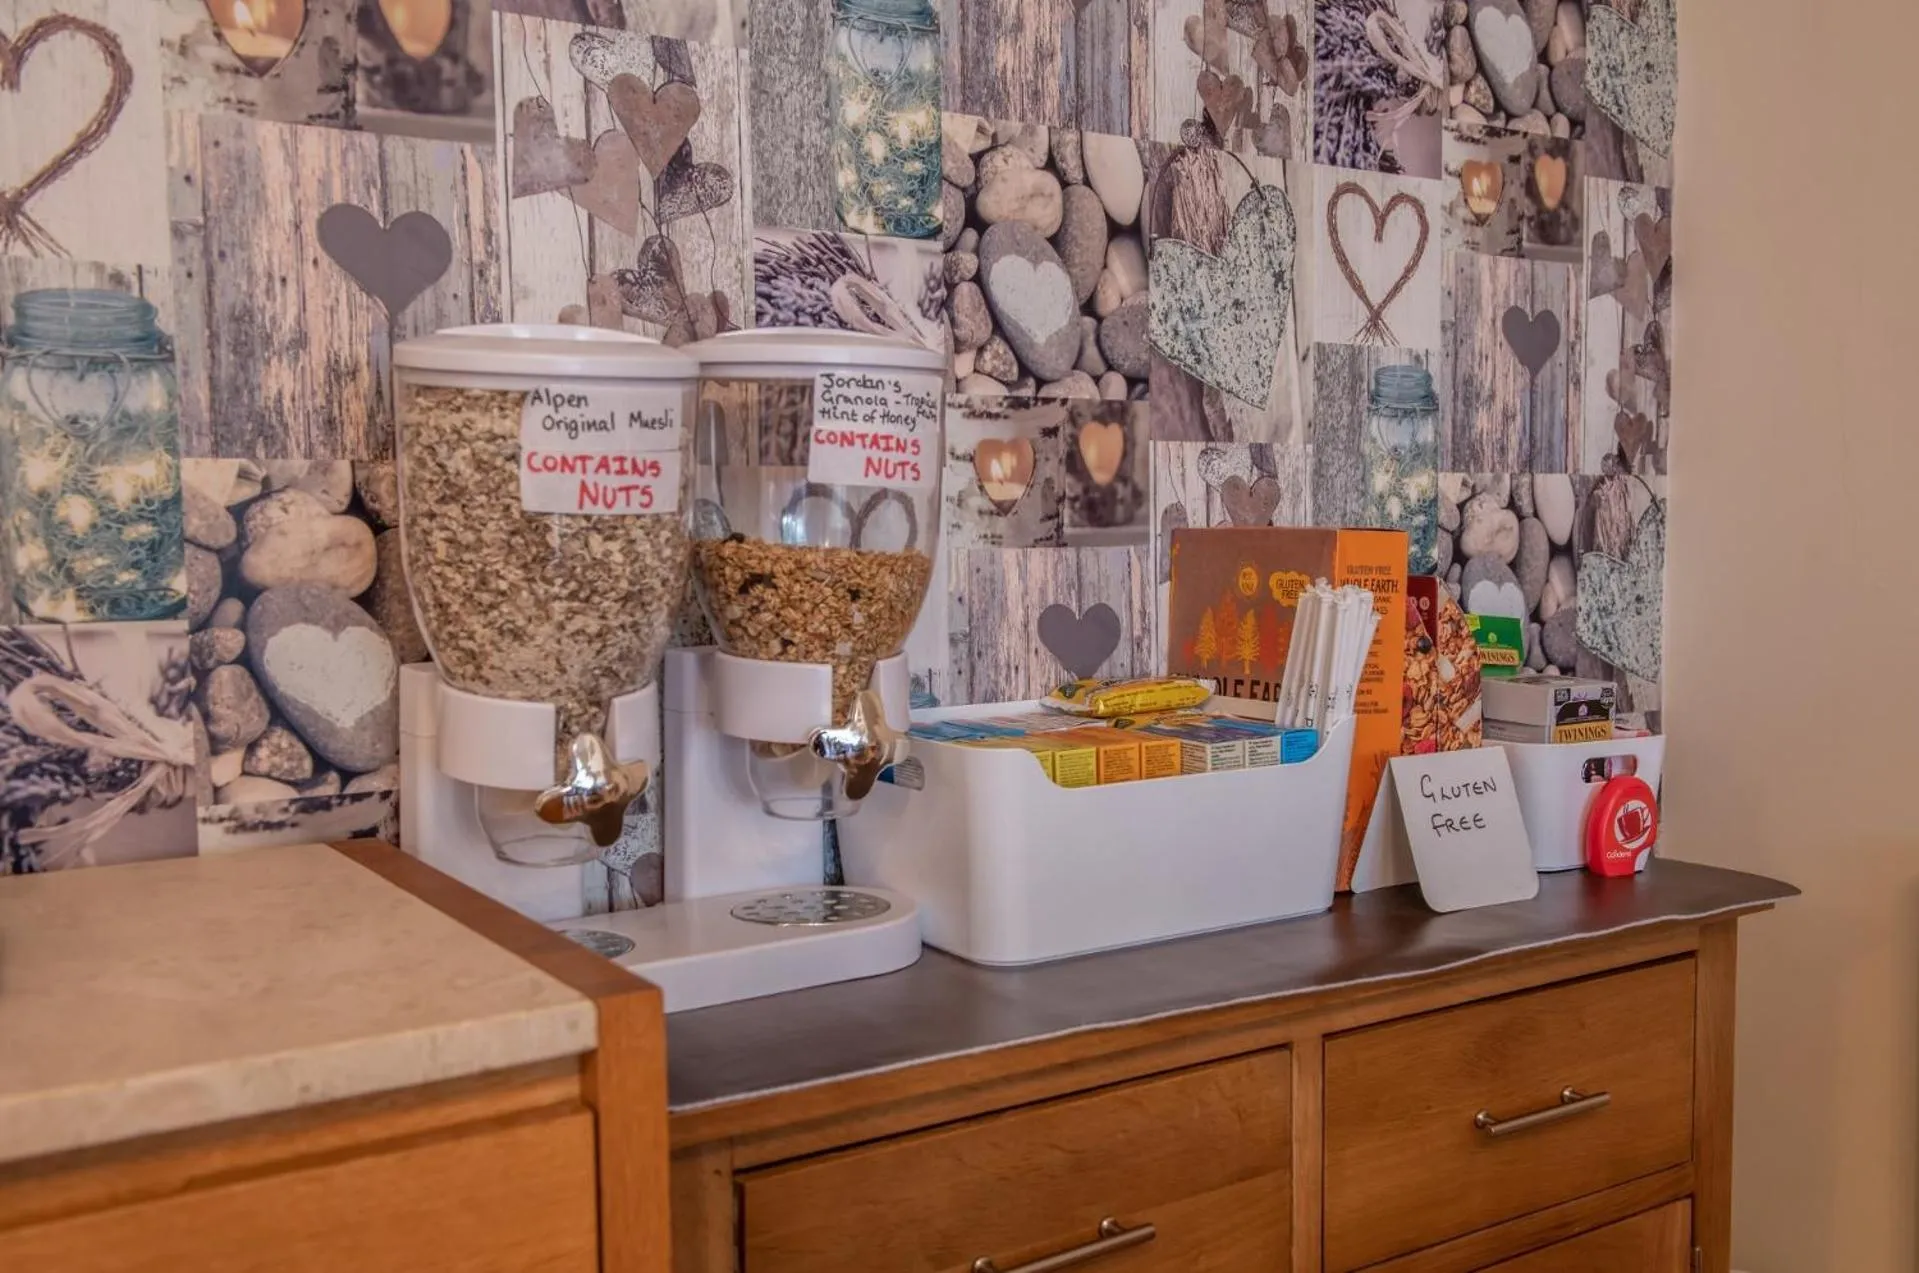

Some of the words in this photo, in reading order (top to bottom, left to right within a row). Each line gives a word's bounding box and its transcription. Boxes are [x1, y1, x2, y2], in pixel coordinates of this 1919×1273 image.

[820, 373, 902, 393] Jordan's
[531, 388, 588, 413] Alpen
[821, 389, 888, 407] Granola
[542, 411, 615, 440] Original
[629, 408, 674, 430] Muesli
[819, 405, 858, 422] Hint
[863, 409, 877, 423] of
[880, 409, 916, 432] Honey
[814, 430, 920, 456] CONTAINS
[526, 451, 662, 478] CONTAINS
[864, 456, 921, 481] NUTS
[577, 479, 654, 510] NUTS
[1371, 578, 1399, 593] EARTH
[1557, 722, 1608, 744] TWININGS
[1420, 774, 1497, 803] GLUTEN
[1431, 813, 1487, 838] FREE
